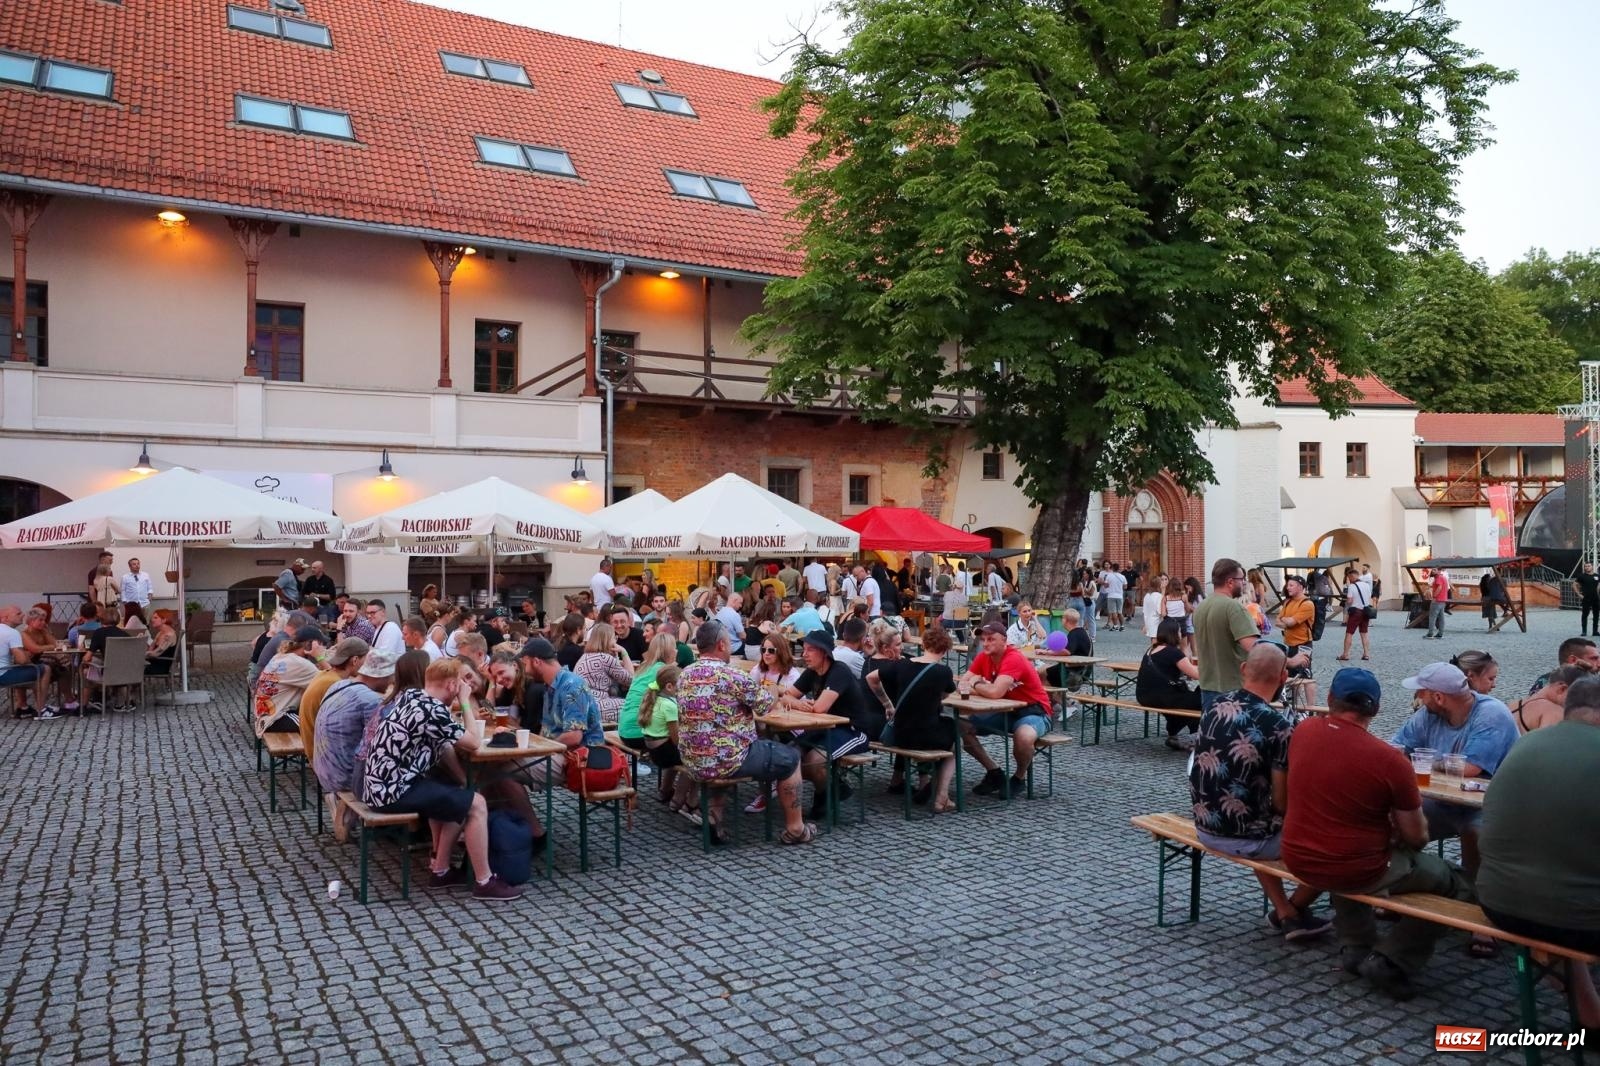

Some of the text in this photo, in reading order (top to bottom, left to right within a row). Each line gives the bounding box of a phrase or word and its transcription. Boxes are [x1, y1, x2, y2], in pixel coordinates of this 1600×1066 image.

[16, 522, 87, 543] RACIBORSKIE
[139, 520, 232, 536] RACIBORSKIE
[277, 520, 330, 536] RACIBORSKIE
[401, 517, 473, 533] RACIBORSKIE
[516, 520, 582, 543] RACIBORSKIE
[720, 535, 786, 548] RACIBORSKIE
[816, 535, 851, 548] RACIBORSKIE
